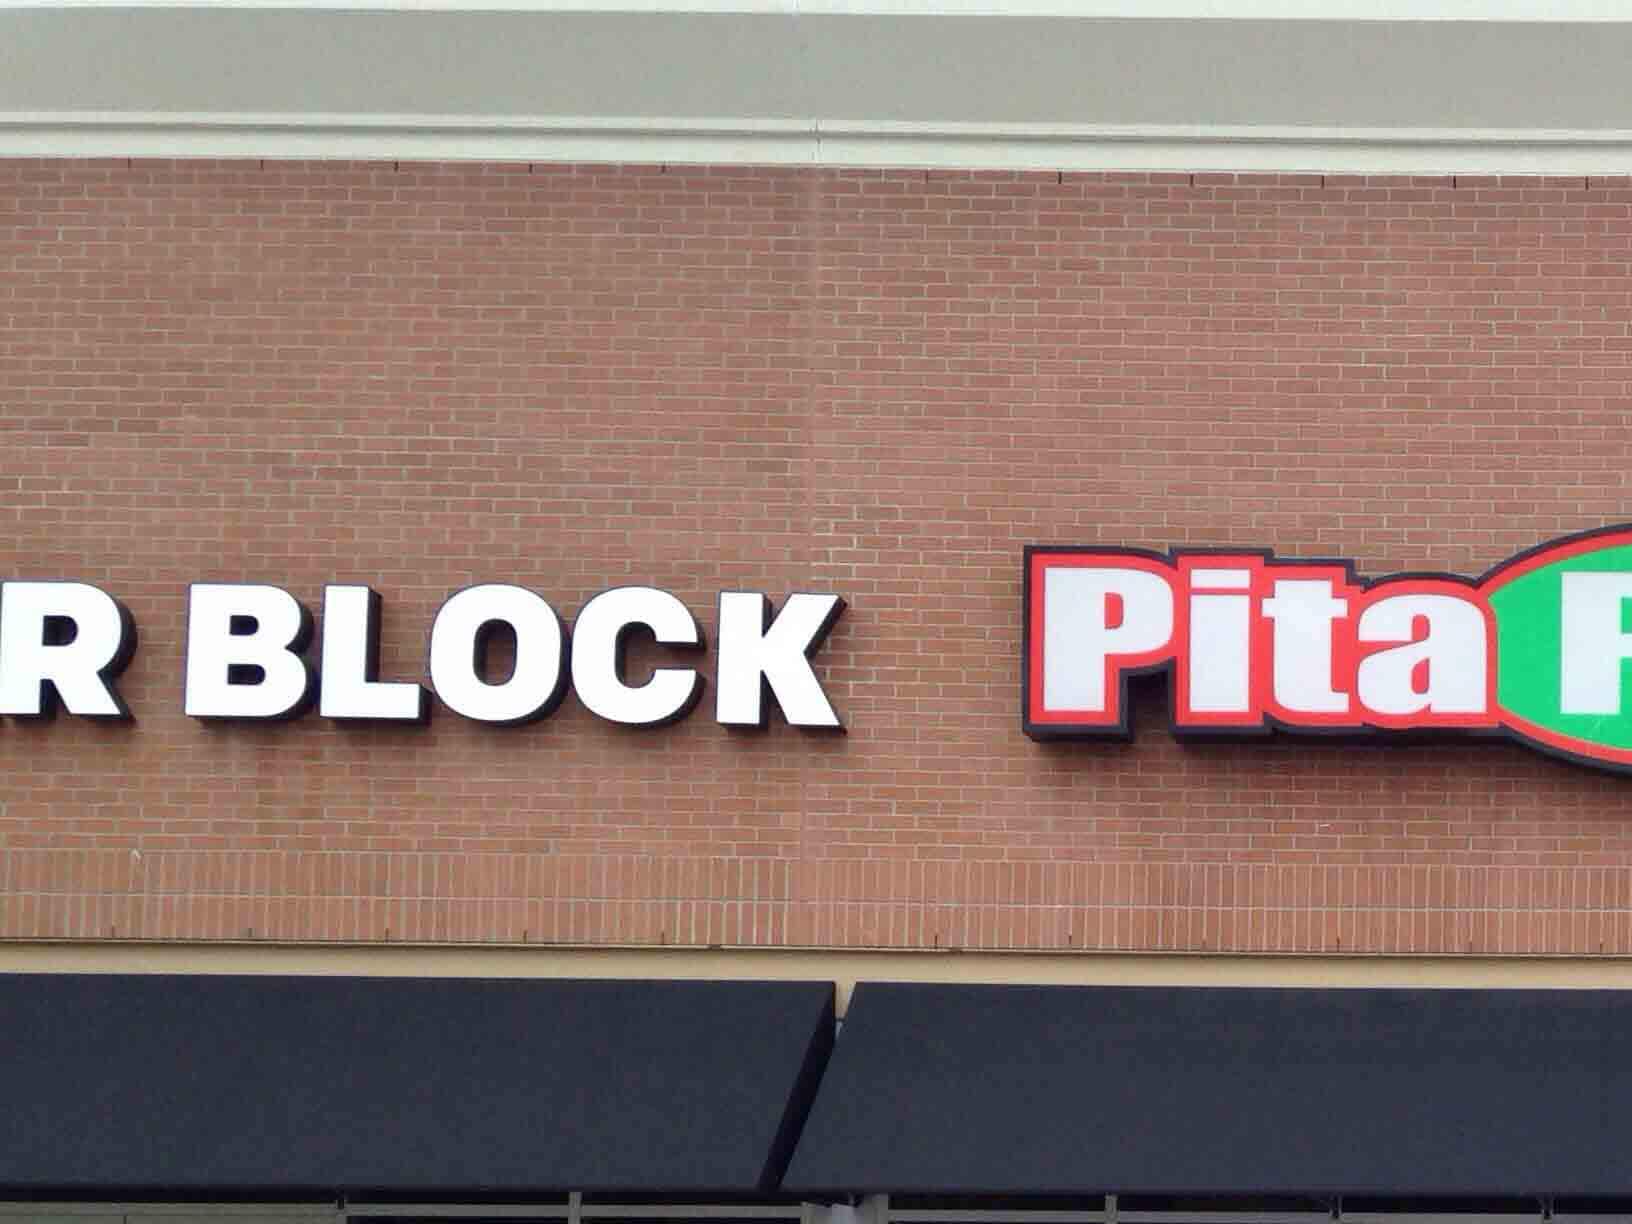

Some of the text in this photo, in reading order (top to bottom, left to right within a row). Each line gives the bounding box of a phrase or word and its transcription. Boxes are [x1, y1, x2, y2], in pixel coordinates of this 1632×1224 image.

[0, 581, 846, 731] R BLOCK
[1042, 566, 1489, 714] Pita
